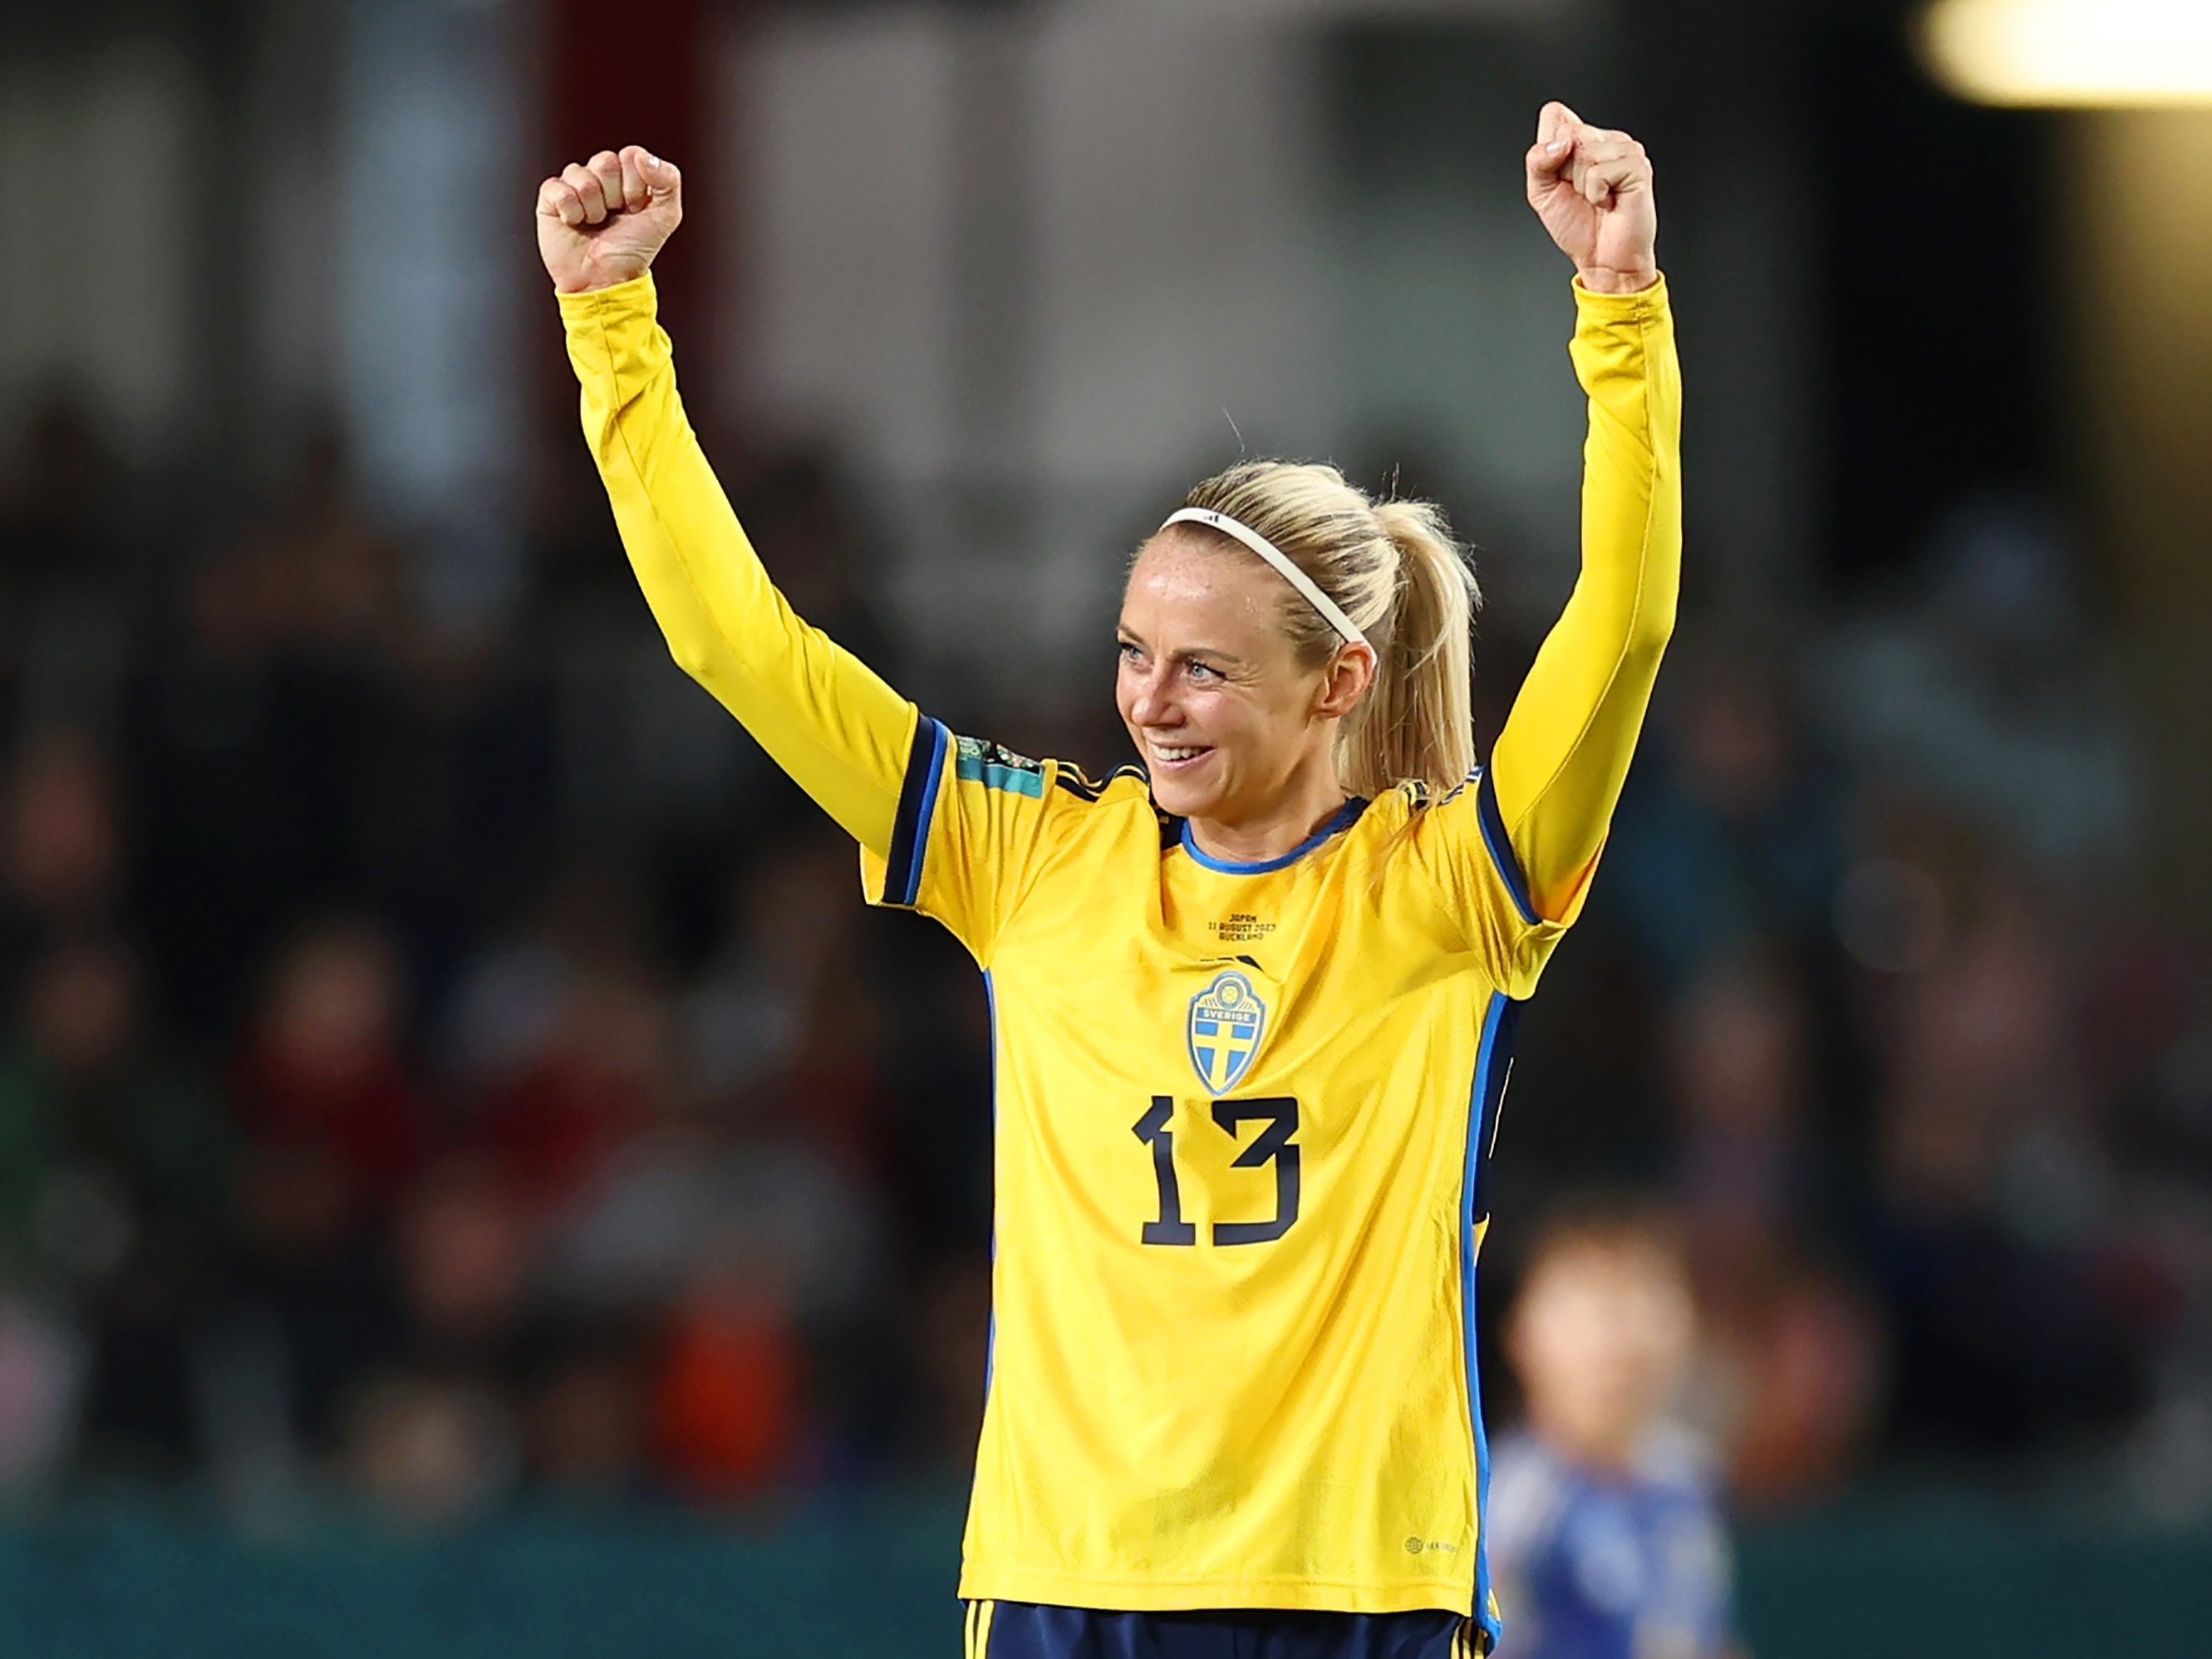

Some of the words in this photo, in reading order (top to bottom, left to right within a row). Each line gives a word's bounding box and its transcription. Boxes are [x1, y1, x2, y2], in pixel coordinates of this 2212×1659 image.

[1230, 914, 1256, 923] JAPAN
[1219, 923, 1252, 932] AUGUST
[1219, 932, 1264, 941] AUCKLAND
[1203, 1009, 1251, 1022] SVERIGE
[1131, 1095, 1300, 1246] 13
